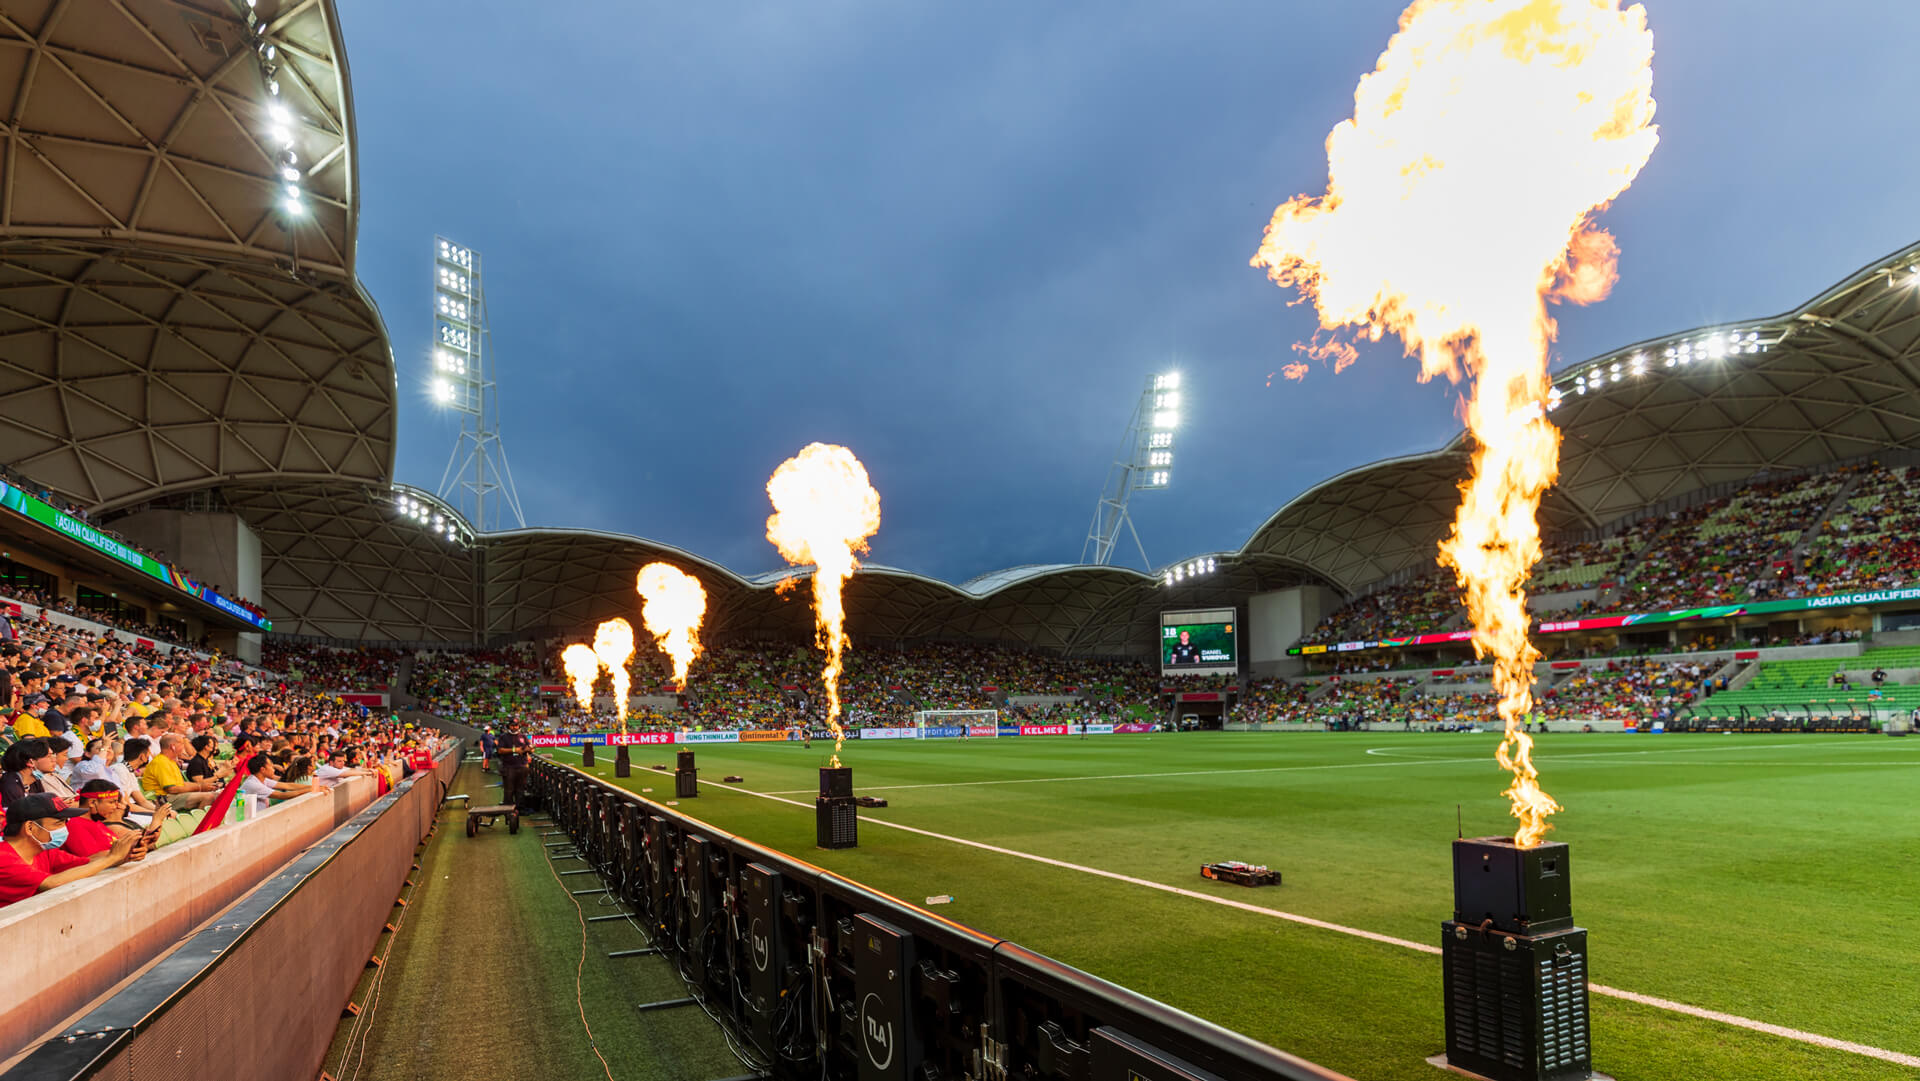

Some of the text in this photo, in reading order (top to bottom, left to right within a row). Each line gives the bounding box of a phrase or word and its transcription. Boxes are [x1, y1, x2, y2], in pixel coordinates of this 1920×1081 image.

[58, 516, 81, 537] ASIAN
[82, 527, 117, 554] QUALIFIERS
[1812, 595, 1852, 607] ASIAN
[1024, 726, 1057, 735] KELME
[533, 737, 569, 745] KONAMI
[612, 735, 658, 745] KELME
[867, 1015, 887, 1048] TLA
